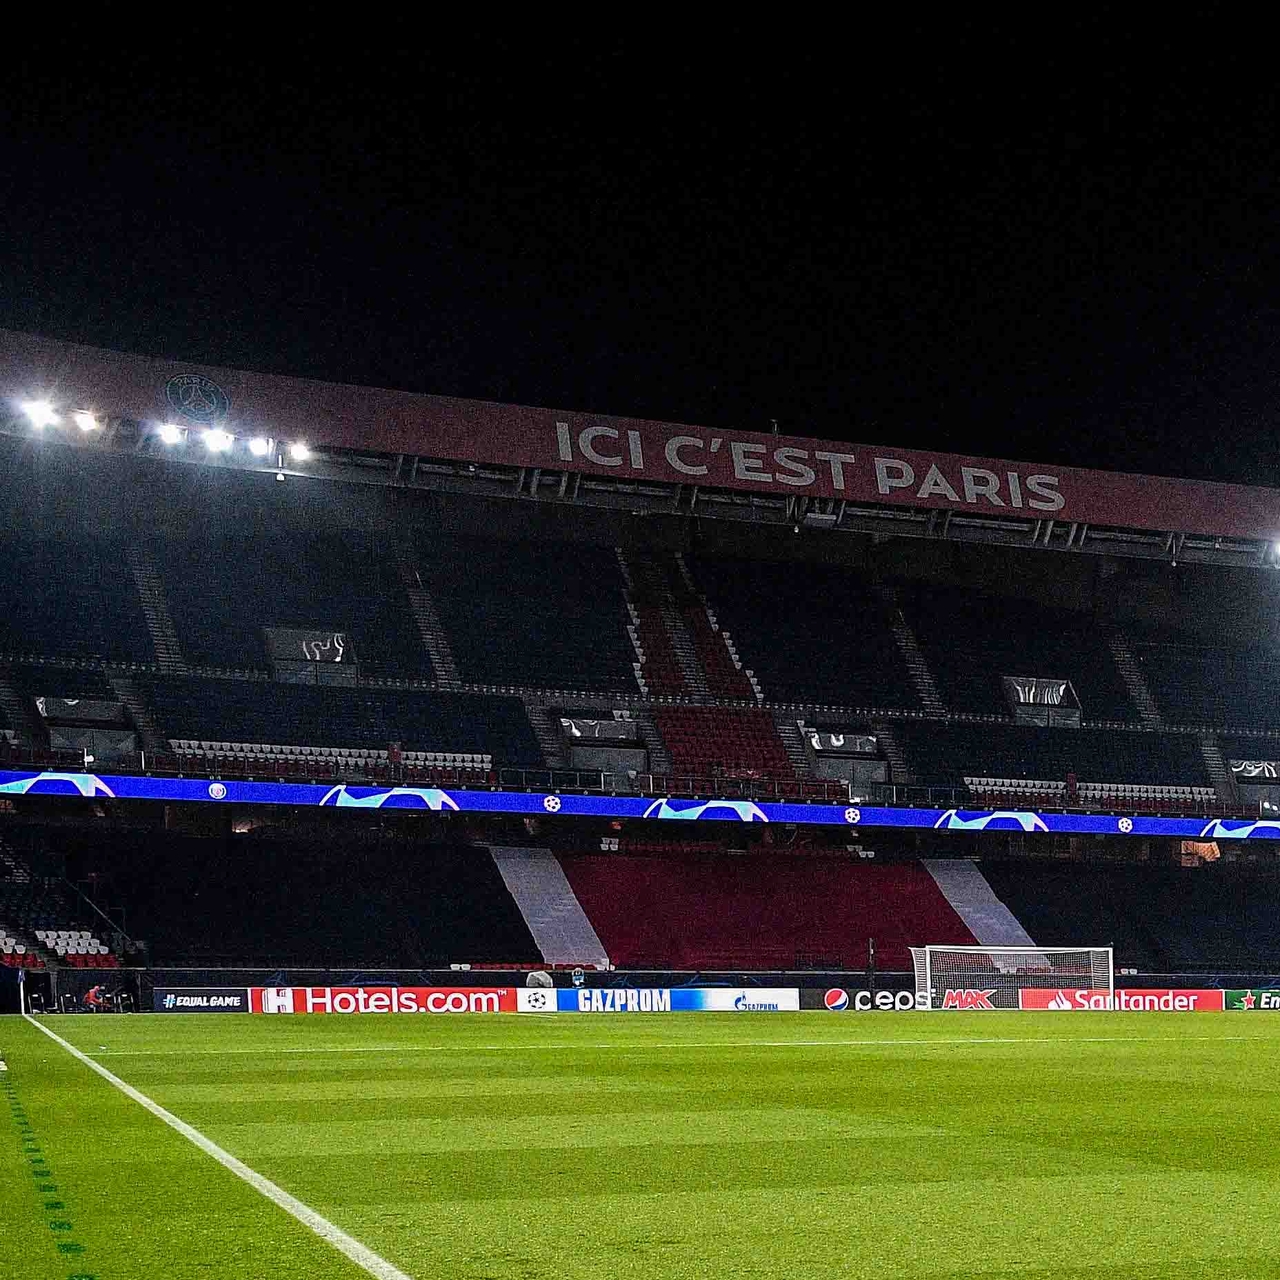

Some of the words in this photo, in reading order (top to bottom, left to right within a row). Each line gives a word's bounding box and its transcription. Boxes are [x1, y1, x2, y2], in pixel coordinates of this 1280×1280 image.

[555, 421, 644, 469] ICI
[664, 438, 855, 490] C'EST
[874, 457, 1067, 511] PARIS
[210, 995, 241, 1007] GAME
[577, 988, 671, 1012] GAZPROM
[942, 988, 998, 1010] MAX
[1074, 990, 1198, 1011] Santander
